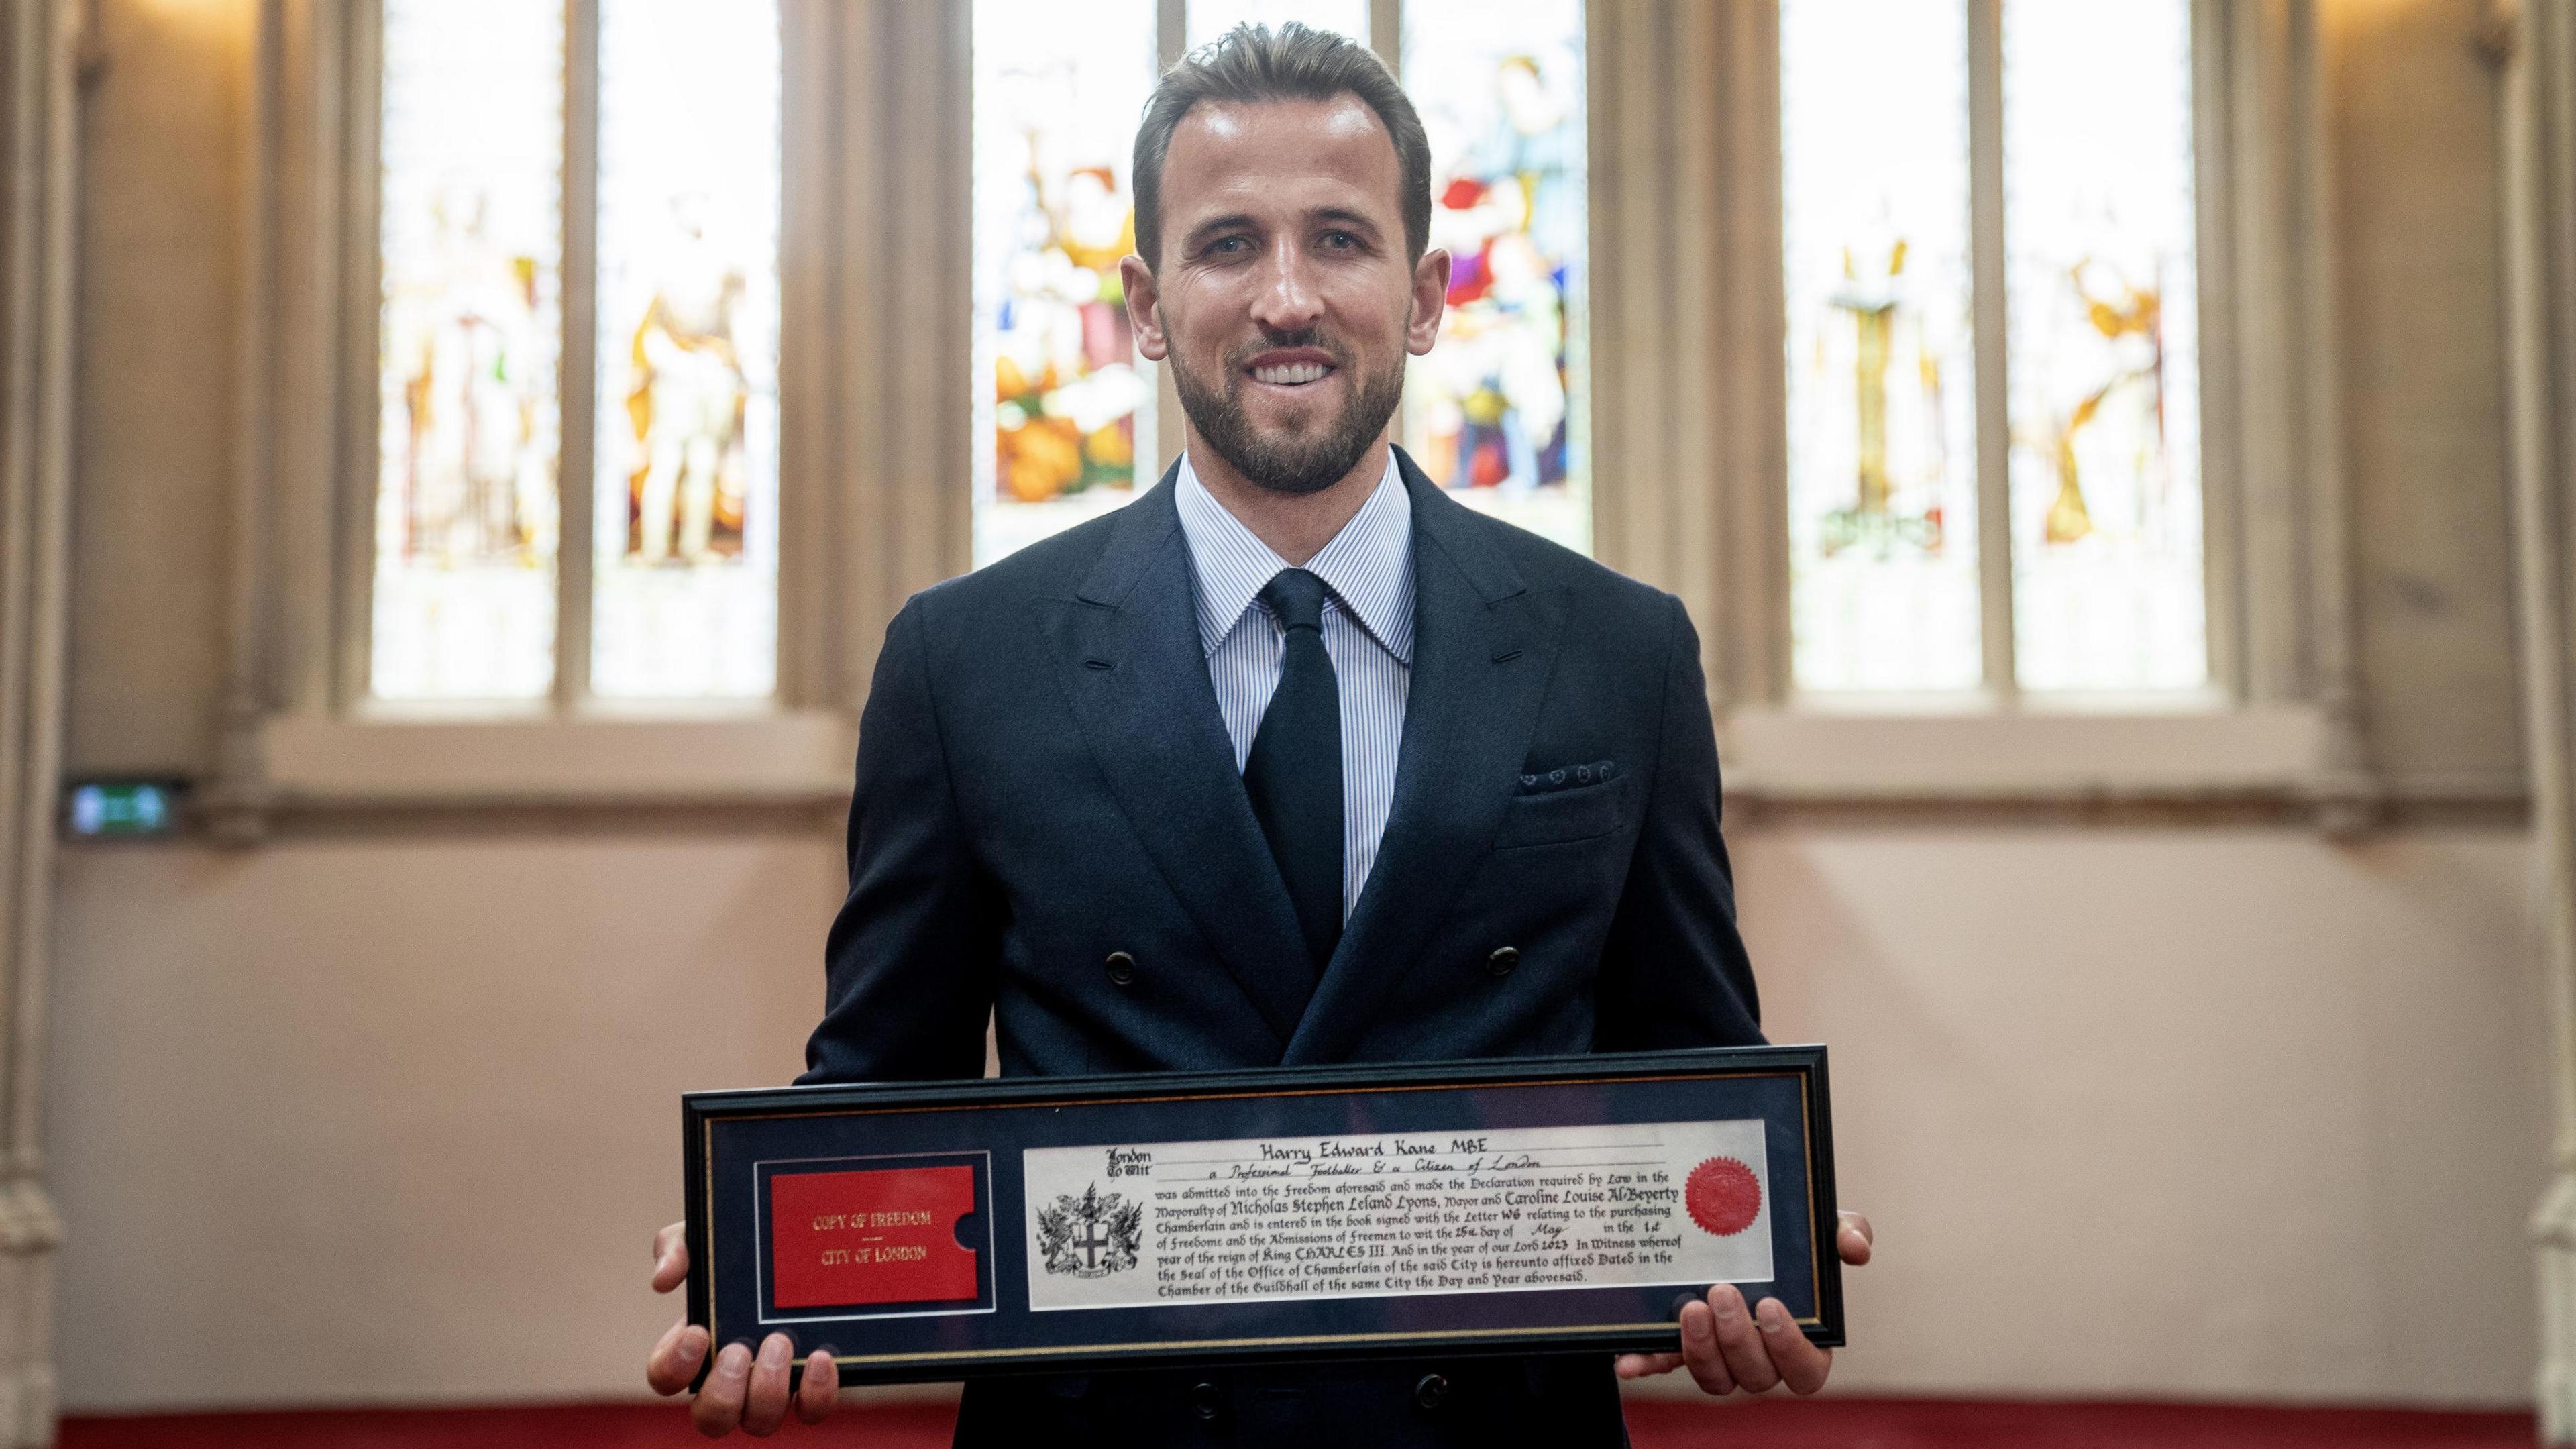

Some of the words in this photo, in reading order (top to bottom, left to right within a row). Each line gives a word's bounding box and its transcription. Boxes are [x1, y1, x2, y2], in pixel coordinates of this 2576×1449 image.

[1106, 1148, 1152, 1165] London
[1260, 1144, 1311, 1165] Harry
[1320, 1141, 1384, 1157] Edward
[1395, 1140, 1436, 1155] Kane
[1451, 1138, 1488, 1154] MBE
[1209, 1171, 1217, 1179] a
[1228, 1164, 1291, 1183] Professional
[1309, 1163, 1362, 1180] Footballer
[1415, 1158, 1454, 1171] Citizen
[1468, 1157, 1483, 1176] of
[1487, 1155, 1541, 1171] London
[1154, 1191, 1177, 1200] was
[1182, 1185, 1230, 1199] admitted
[1236, 1187, 1257, 1197] into
[1263, 1185, 1279, 1197] the
[1335, 1180, 1385, 1195] aforesaid
[1390, 1179, 1410, 1191] and
[1415, 1178, 1443, 1190] made
[1448, 1178, 1465, 1191] the
[1470, 1177, 1534, 1189] Declaration
[1539, 1173, 1583, 1187] required
[1589, 1173, 1602, 1187] by
[1607, 1173, 1631, 1184] Law
[1636, 1172, 1648, 1183] in
[1652, 1170, 1669, 1183] the
[1155, 1204, 1215, 1220] Mayoralty
[1216, 1203, 1227, 1217] of
[1230, 1198, 1288, 1216] Nicholas
[1292, 1197, 1344, 1214] Stephen
[1347, 1194, 1393, 1211] Leland
[1395, 1195, 1440, 1212] Lyons,
[1444, 1196, 1479, 1209] Mayor
[1481, 1193, 1501, 1205] and
[1505, 1189, 1558, 1205] Caroline
[1562, 1190, 1604, 1203] Louise
[812, 1214, 846, 1230] COPY
[851, 1213, 867, 1228] OF
[871, 1210, 931, 1227] FREEDOM
[1155, 1220, 1225, 1234] Chamberlain
[1229, 1219, 1250, 1230] and
[1267, 1216, 1307, 1229] entered
[1311, 1218, 1322, 1227] in
[1326, 1215, 1342, 1228] the
[1346, 1214, 1371, 1226] book
[1376, 1212, 1410, 1226] signed
[1414, 1212, 1440, 1224] with
[1444, 1211, 1459, 1224] the
[1464, 1212, 1498, 1222] Letter
[1527, 1208, 1570, 1222] relating
[1574, 1208, 1585, 1218] to
[1589, 1205, 1605, 1218] the
[1610, 1204, 1672, 1219] purchasing
[1156, 1237, 1167, 1250] of
[1226, 1234, 1246, 1246] and
[1249, 1234, 1265, 1246] the
[1269, 1233, 1332, 1245] Admissions
[1336, 1230, 1346, 1243] of
[1399, 1230, 1411, 1240] to
[1413, 1229, 1432, 1239] wit
[1436, 1227, 1452, 1238] the
[1480, 1226, 1500, 1239] day
[1503, 1225, 1513, 1238] of
[1531, 1223, 1568, 1240] May
[1603, 1224, 1614, 1232] in
[1617, 1222, 1633, 1234] the
[821, 1249, 851, 1265] CITY
[855, 1248, 871, 1264] OF
[875, 1246, 927, 1263] LONDON
[1157, 1256, 1181, 1268] year
[1184, 1252, 1195, 1265] of
[1198, 1251, 1214, 1264] the
[1218, 1254, 1245, 1265] reign
[1248, 1249, 1258, 1263] of
[1262, 1247, 1291, 1263] King
[1391, 1243, 1414, 1256] And
[1417, 1247, 1428, 1255] in
[1431, 1244, 1447, 1255] the
[1450, 1245, 1474, 1256] year
[1478, 1241, 1488, 1254] of
[1491, 1244, 1510, 1252] our
[1513, 1239, 1539, 1252] Lord
[1591, 1238, 1635, 1250] Witness
[1638, 1234, 1682, 1248] whereof
[1157, 1269, 1175, 1282] the
[1181, 1267, 1206, 1280] Seal
[1210, 1267, 1221, 1280] of
[1225, 1266, 1243, 1279] the
[1248, 1265, 1284, 1279] Office
[1289, 1264, 1300, 1277] of
[1304, 1261, 1381, 1276] Chamberlain
[1384, 1260, 1396, 1274] of
[1400, 1260, 1417, 1273] the
[1423, 1258, 1447, 1271] said
[1450, 1259, 1477, 1272] City
[1481, 1260, 1492, 1269] is
[1496, 1256, 1548, 1269] hereunto
[1552, 1252, 1594, 1268] affixed
[1598, 1252, 1634, 1265] Dated
[1638, 1252, 1650, 1263] in
[1654, 1250, 1672, 1265] the
[1157, 1284, 1211, 1298] Chamber
[1215, 1282, 1226, 1296] of
[1230, 1282, 1248, 1295] the
[1253, 1279, 1308, 1293] Guildhall
[1312, 1279, 1324, 1292] of
[1328, 1279, 1346, 1291] the
[1351, 1281, 1380, 1289] same
[1385, 1277, 1411, 1289] City
[1415, 1275, 1433, 1287] the
[1438, 1275, 1463, 1288] Day
[1467, 1273, 1489, 1285] and
[1492, 1274, 1520, 1287] Year
[1524, 1269, 1587, 1283] abovesaid.
